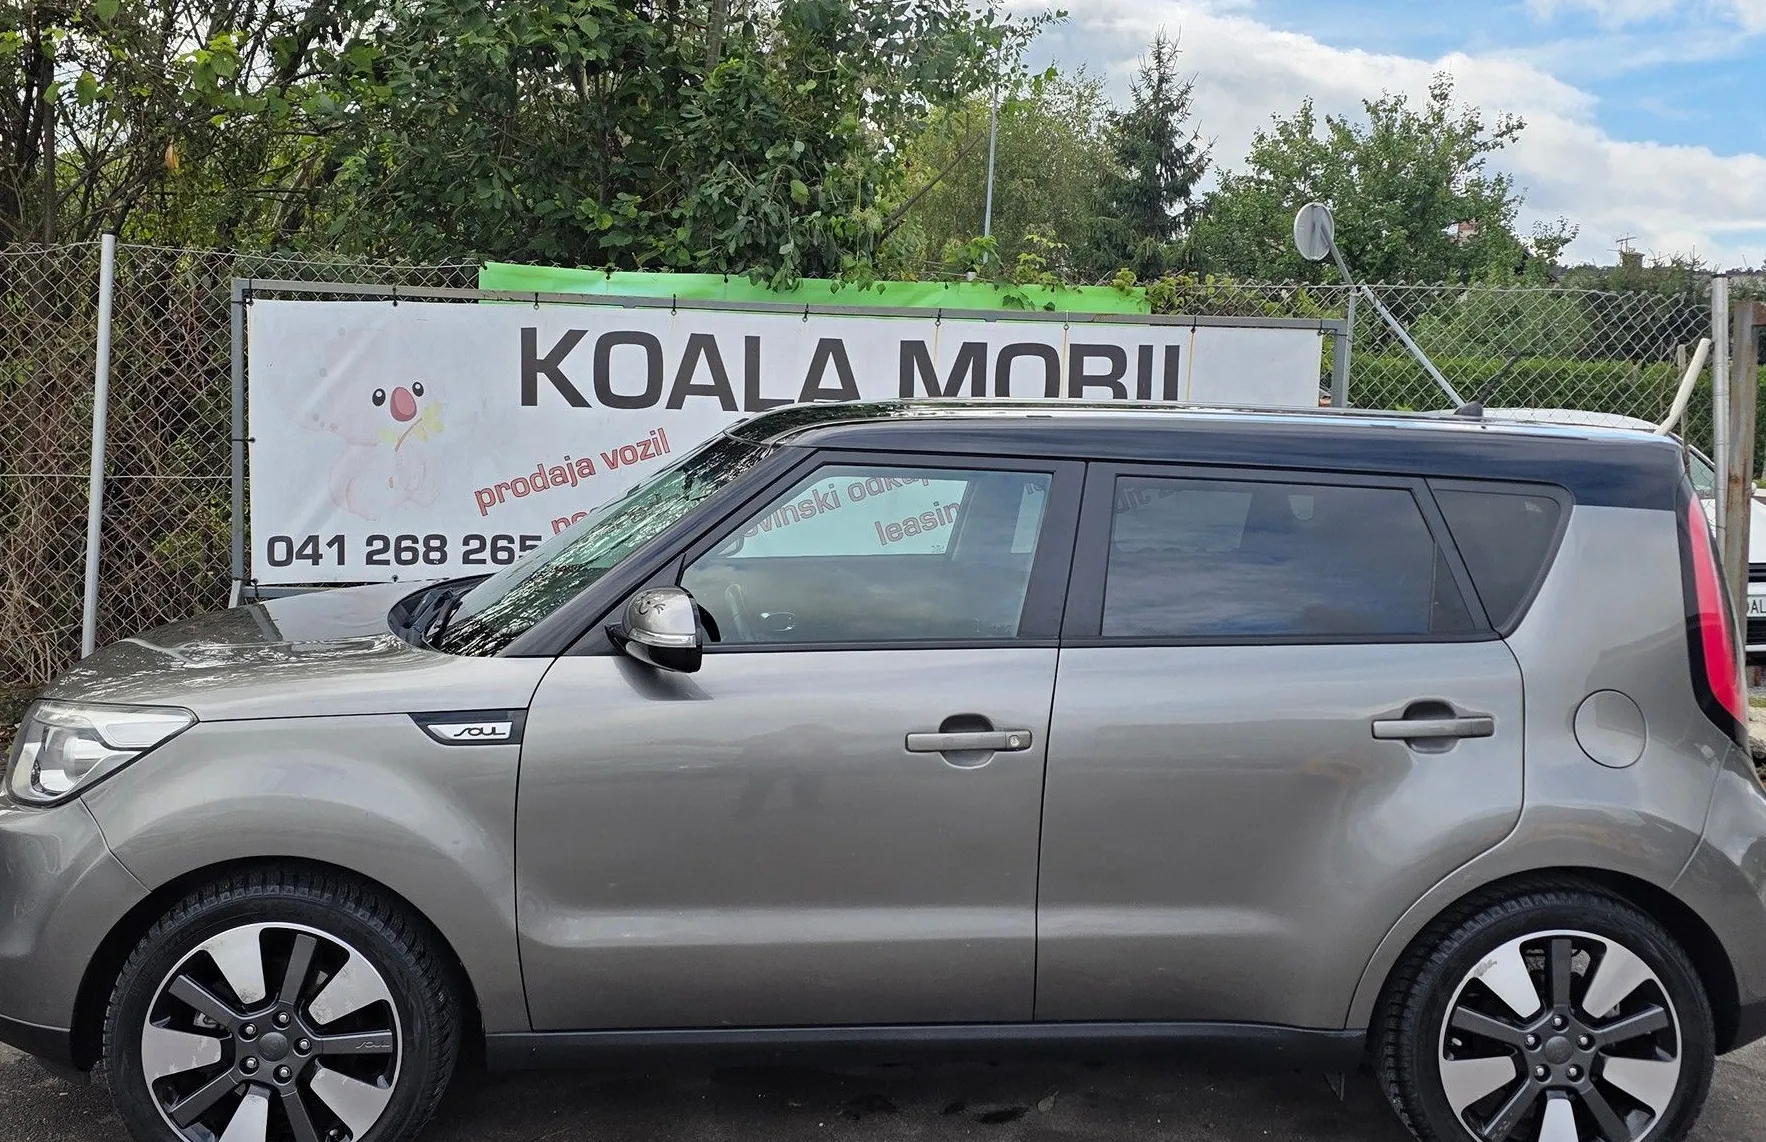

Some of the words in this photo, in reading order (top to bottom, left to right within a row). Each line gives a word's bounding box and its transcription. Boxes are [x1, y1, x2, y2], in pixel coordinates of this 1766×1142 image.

[521, 327, 861, 412] KOALA
[474, 455, 596, 516] prodaja
[600, 427, 671, 470] vozil
[267, 534, 346, 567] 041
[366, 534, 448, 566] 268
[874, 501, 961, 546] leasin
